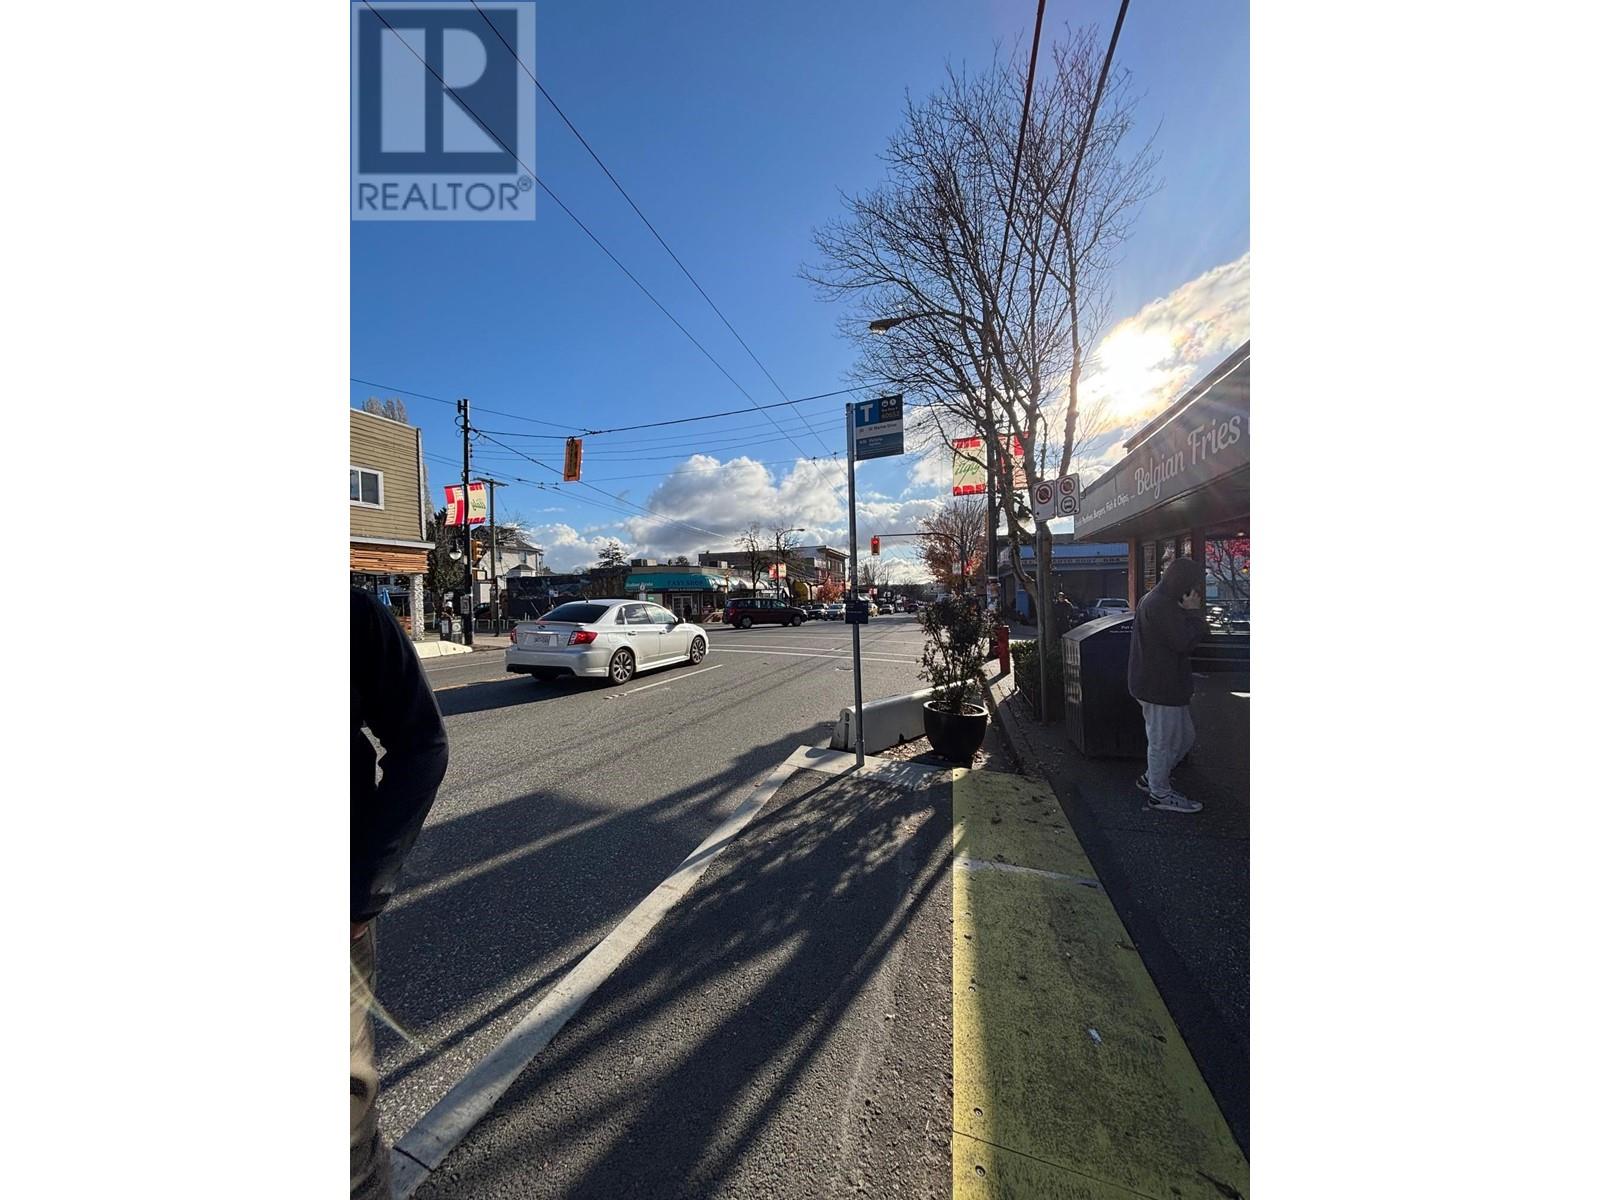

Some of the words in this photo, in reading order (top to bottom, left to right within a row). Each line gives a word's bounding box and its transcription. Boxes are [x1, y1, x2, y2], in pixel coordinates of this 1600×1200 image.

[861, 404, 873, 422] T
[1134, 450, 1185, 500] Belgian
[1187, 416, 1241, 464] Fries
